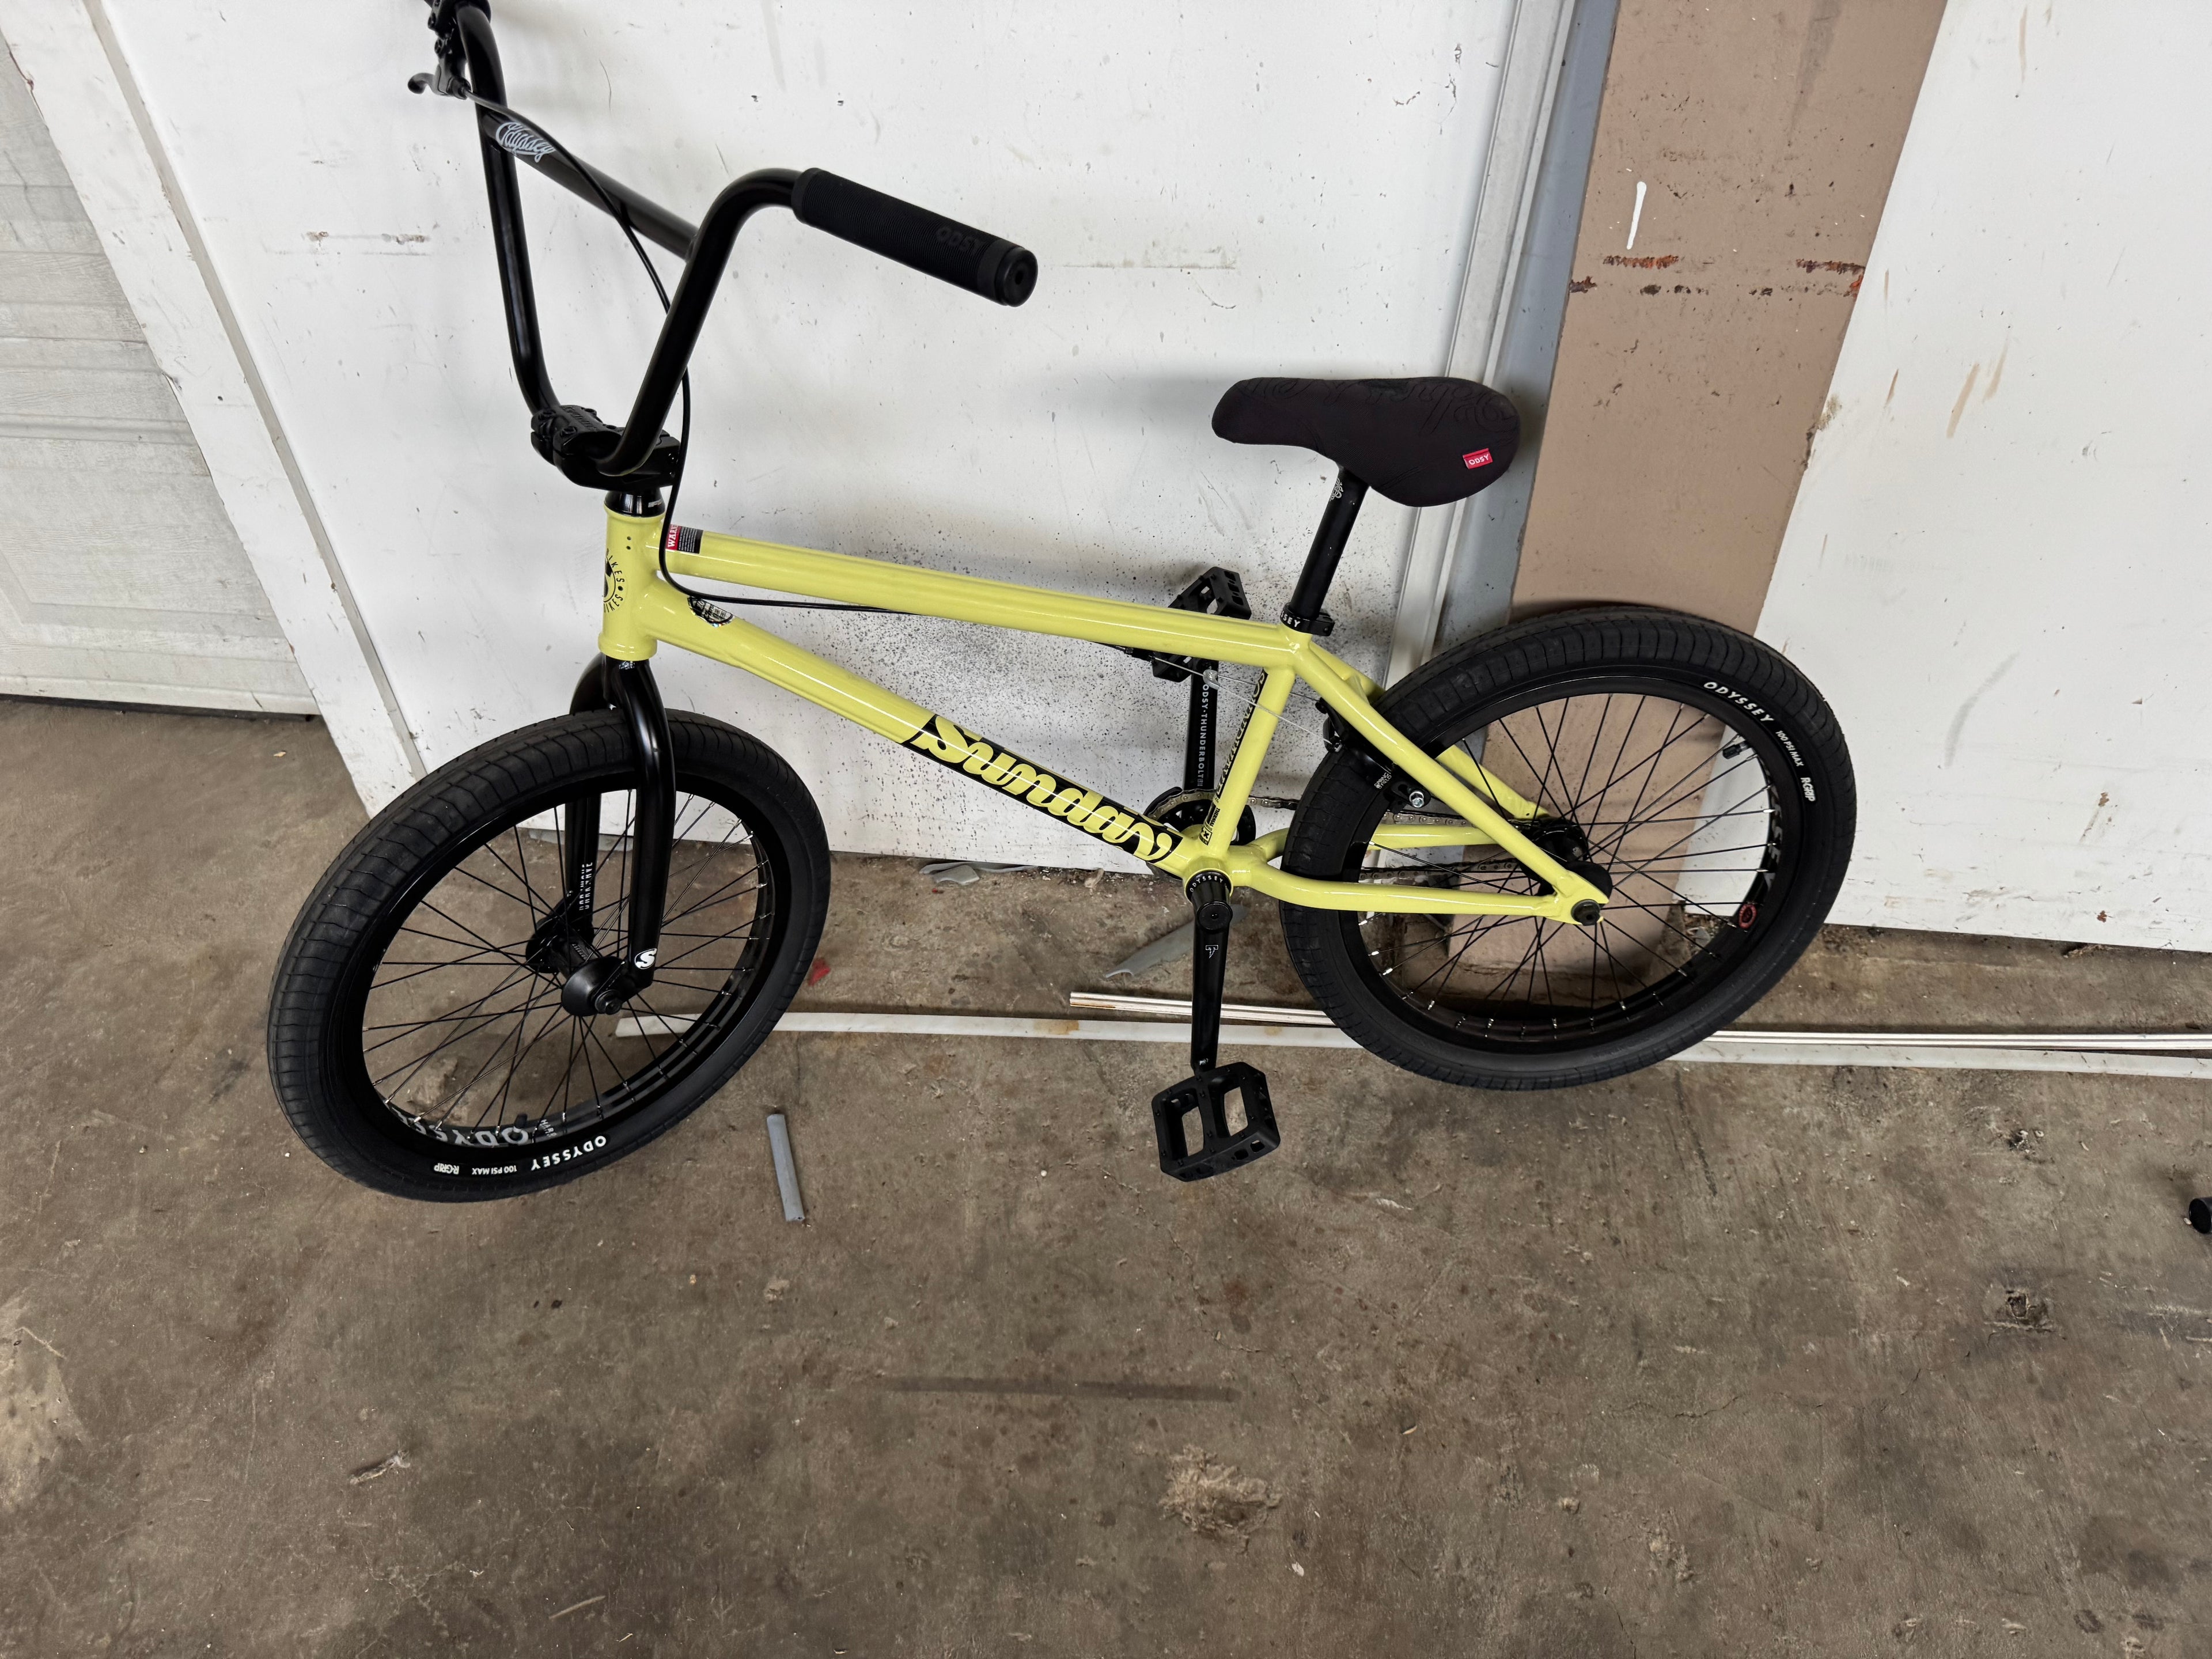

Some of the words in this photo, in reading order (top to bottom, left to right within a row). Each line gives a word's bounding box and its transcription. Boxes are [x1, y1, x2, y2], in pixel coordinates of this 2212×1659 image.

[1469, 454, 1489, 465] ODSY
[668, 525, 679, 547] WARN
[606, 548, 625, 582] IKES
[1703, 682, 1774, 721] ODYSSEY
[1775, 730, 1789, 741] 100
[1783, 741, 1796, 752] PSI
[1790, 751, 1804, 767] MAX
[910, 715, 1172, 861] Sunday
[1190, 876, 1223, 892] ODYSSEY
[531, 1135, 607, 1171] ODYSSEY
